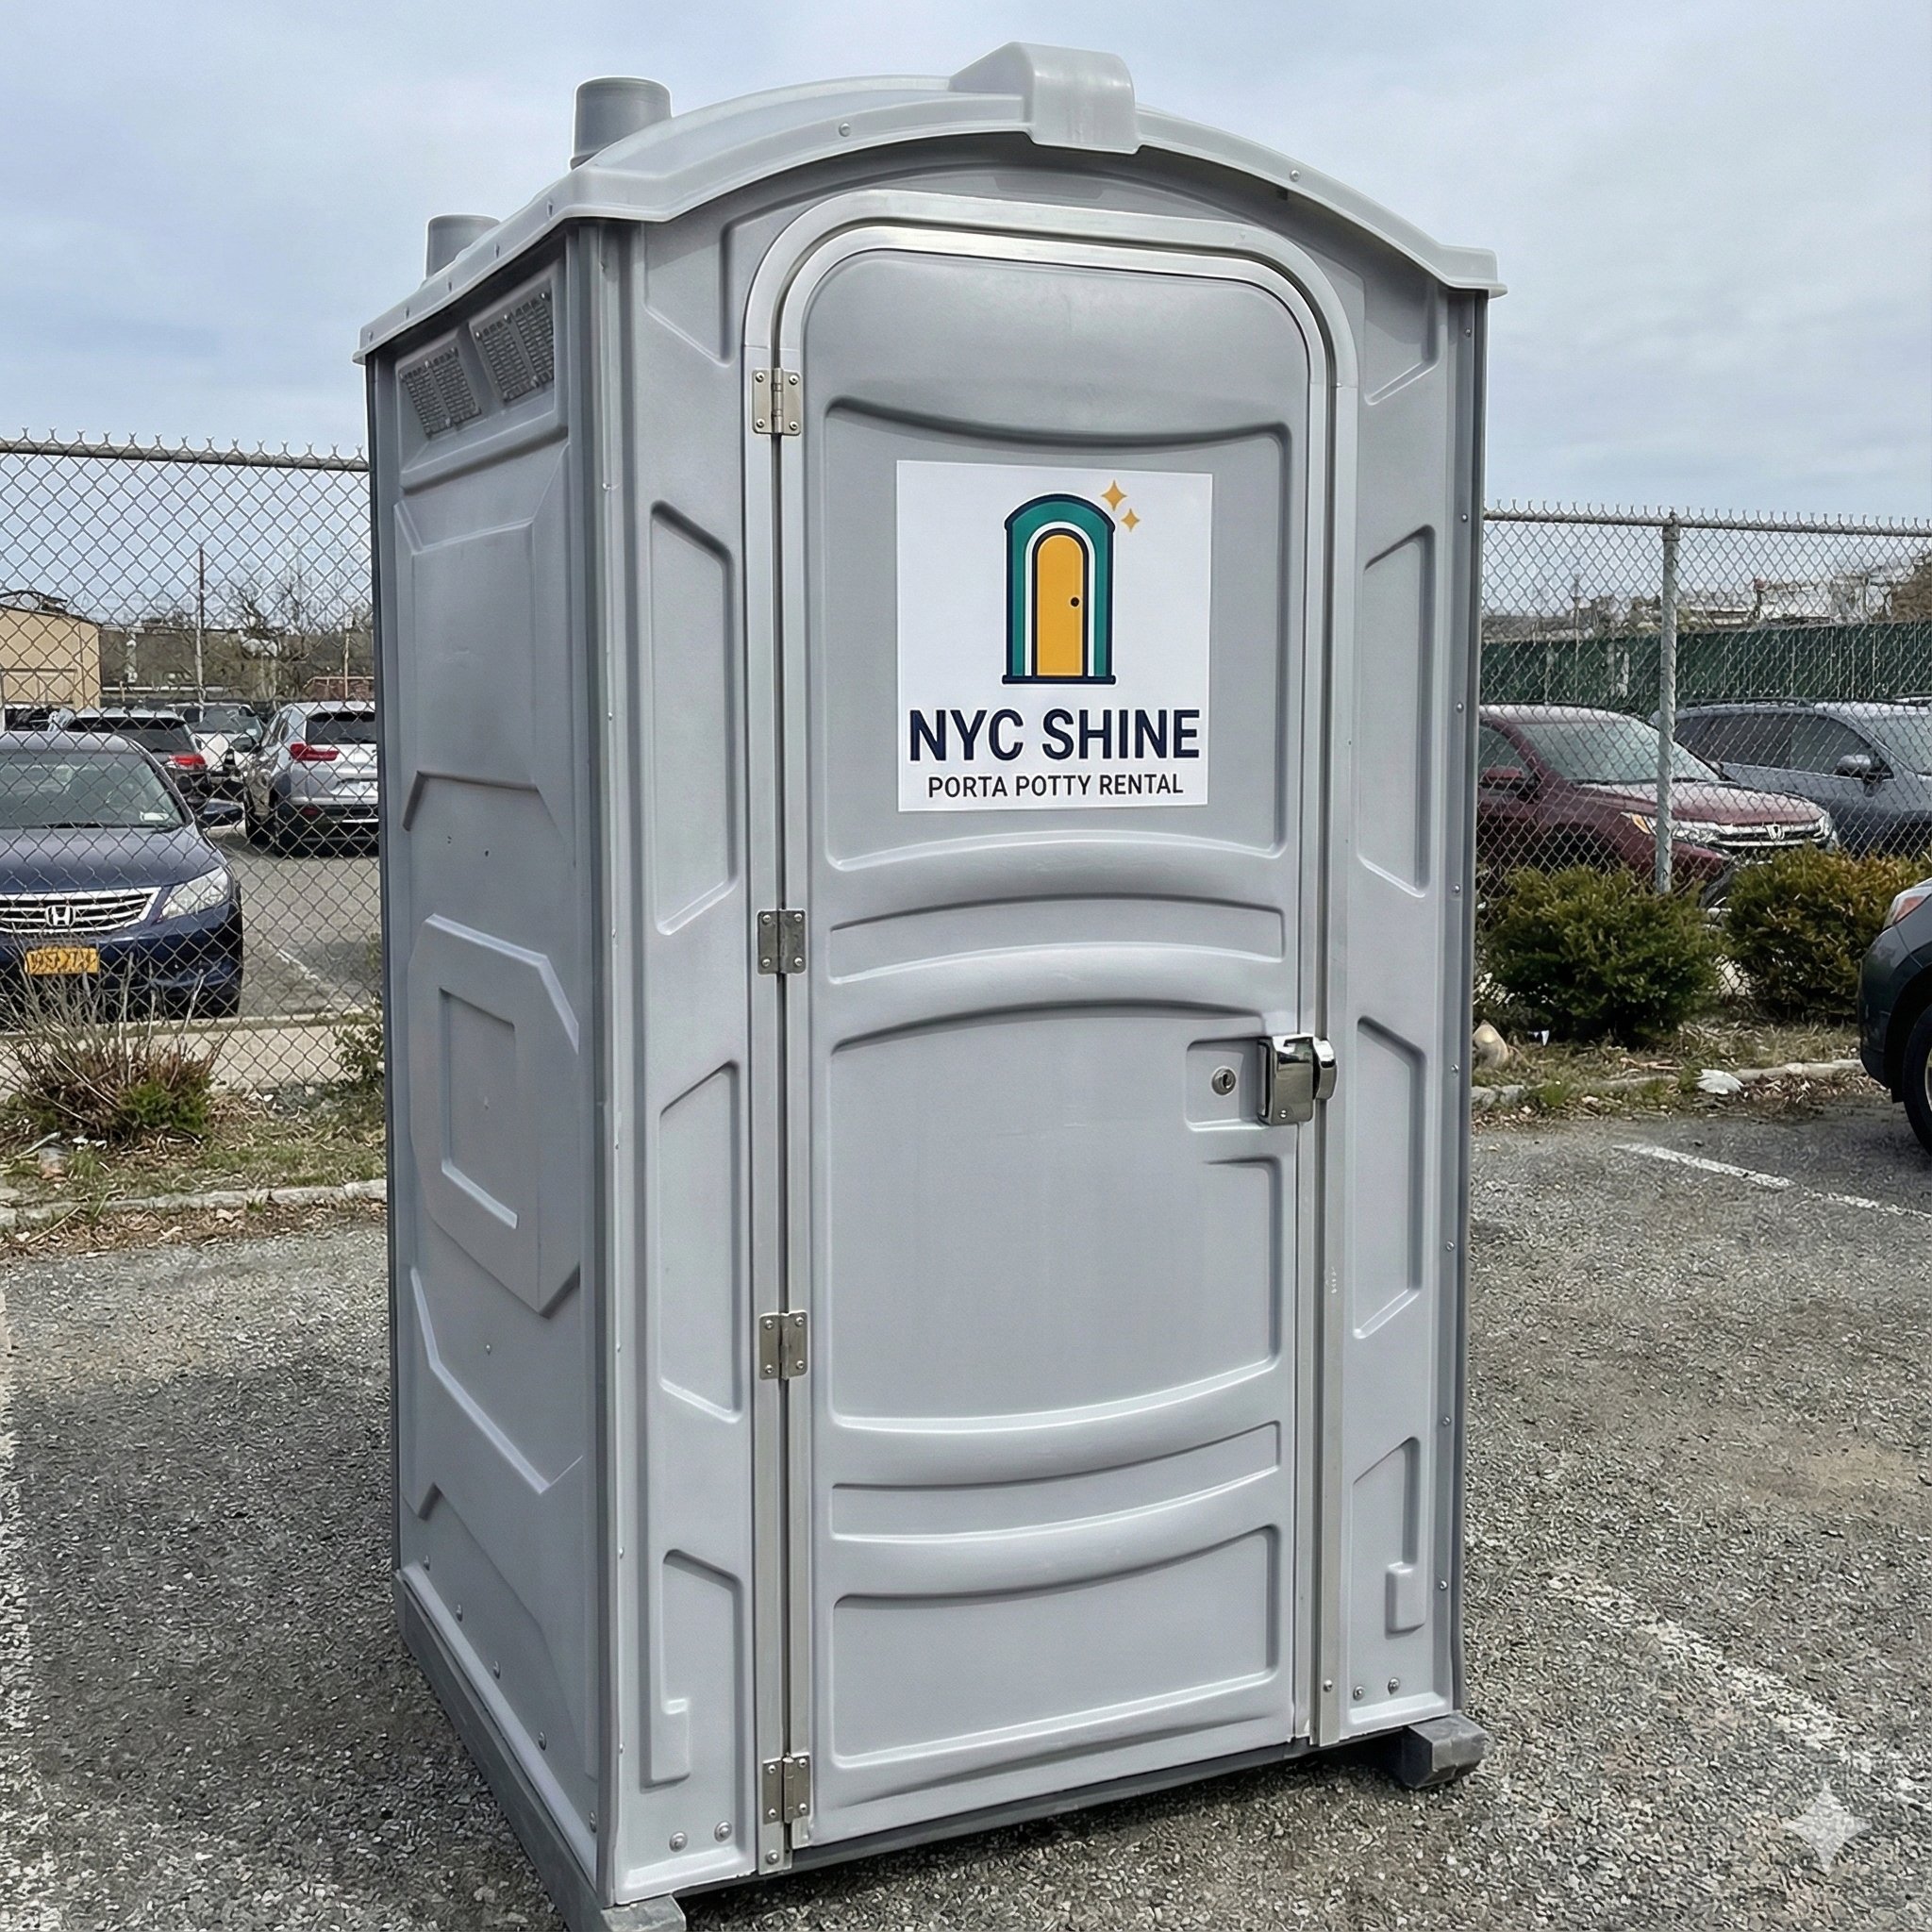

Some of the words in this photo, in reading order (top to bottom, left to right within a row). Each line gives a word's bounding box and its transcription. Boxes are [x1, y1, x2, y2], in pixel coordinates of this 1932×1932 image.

[908, 708, 1024, 762] NYC
[1041, 708, 1201, 761] SHINE
[927, 775, 1008, 798] PORTA
[1014, 774, 1091, 797] POTTY
[1099, 773, 1185, 795] RENTAL
